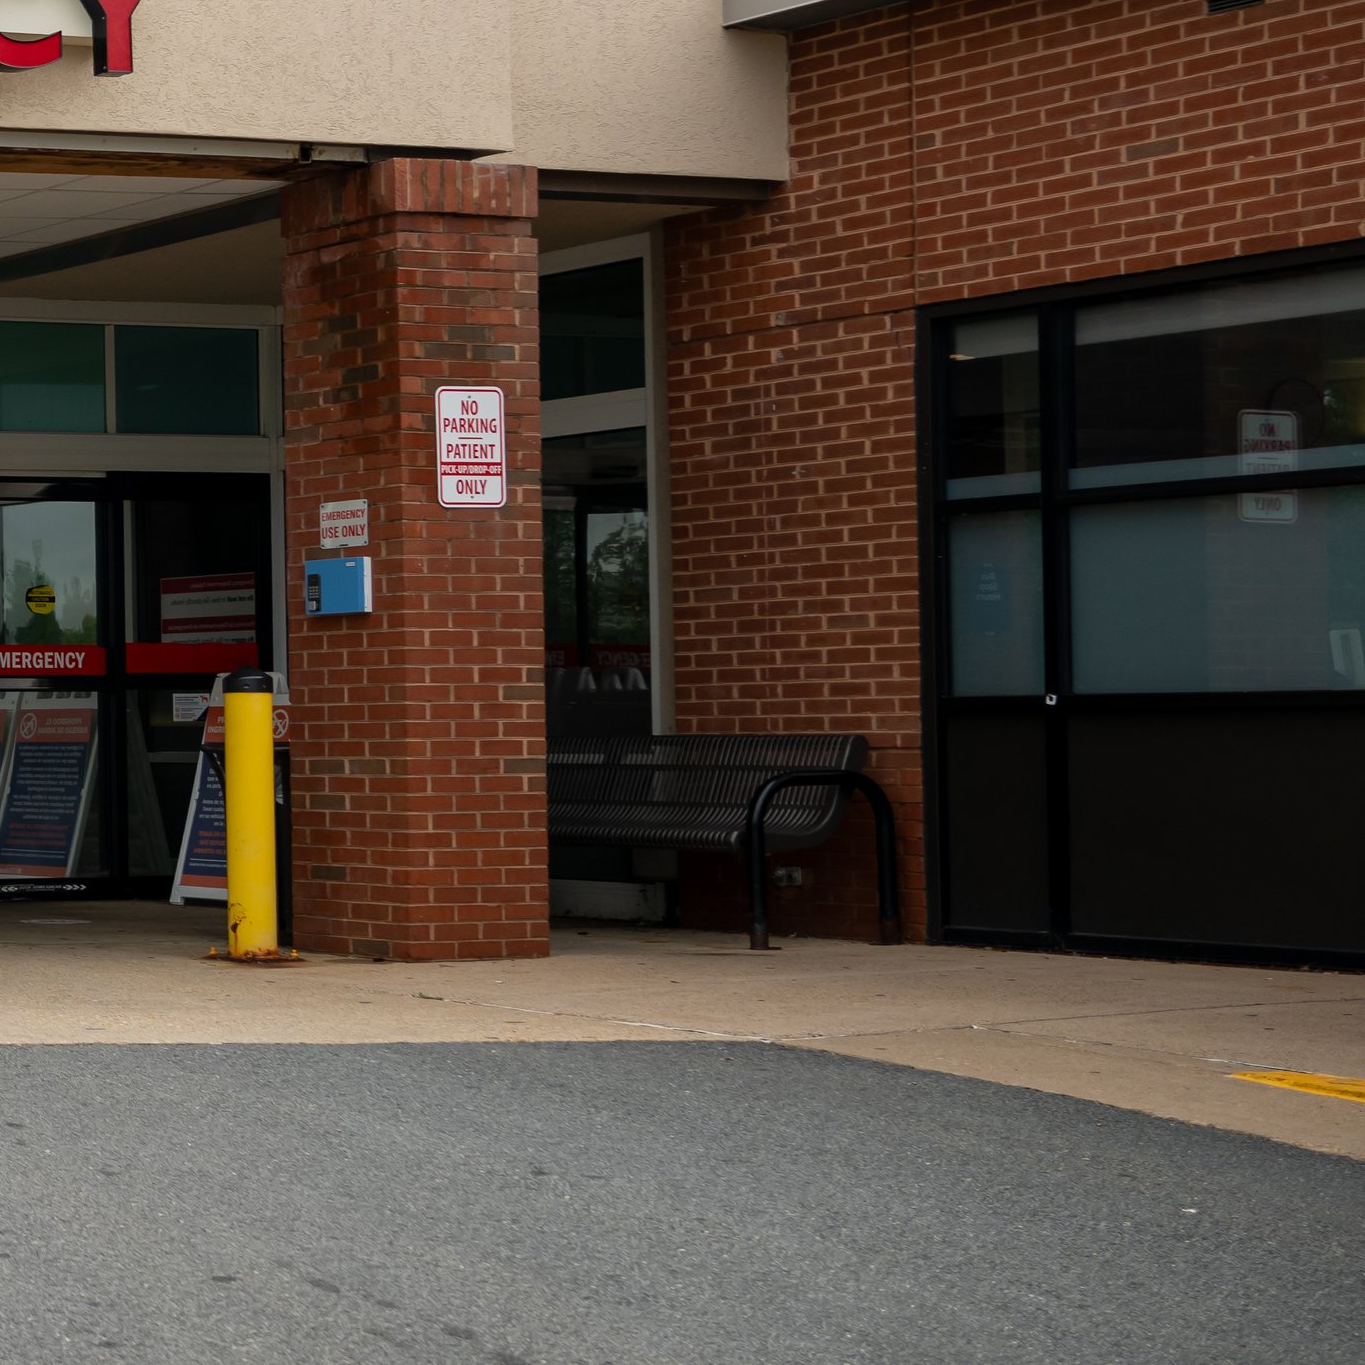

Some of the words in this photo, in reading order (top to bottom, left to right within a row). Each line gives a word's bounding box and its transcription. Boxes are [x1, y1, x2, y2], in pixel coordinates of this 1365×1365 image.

[460, 400, 479, 416] NO
[443, 417, 497, 434] PARKING
[445, 443, 496, 459] PATIENT
[440, 465, 502, 475] PICK-UP/DROP-OFF
[456, 479, 488, 495] ONLY
[321, 508, 366, 522] EMERGENCY
[321, 526, 339, 539] USE
[341, 523, 367, 538] ONLY
